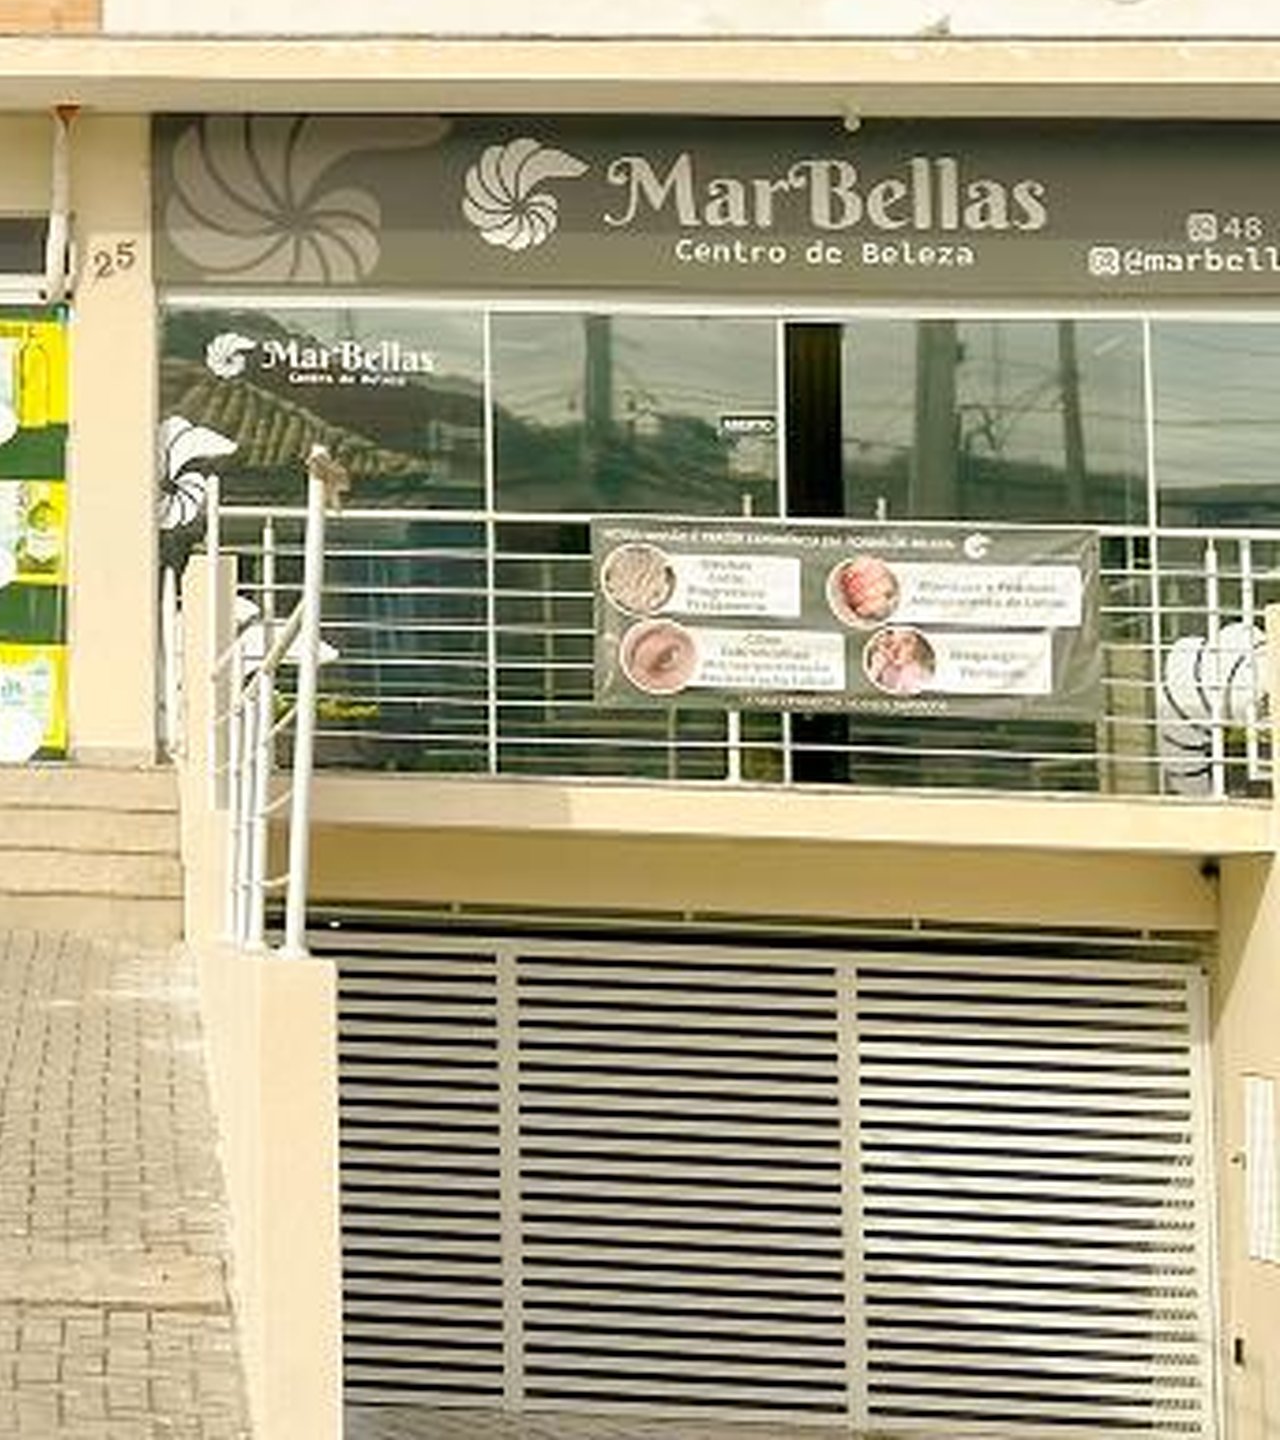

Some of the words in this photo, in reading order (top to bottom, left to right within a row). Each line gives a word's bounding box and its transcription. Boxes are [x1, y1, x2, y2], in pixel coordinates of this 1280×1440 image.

[603, 154, 1048, 231] MarBellas
[1223, 216, 1263, 241] 48
[93, 240, 137, 278] 25
[675, 239, 787, 265] Centro
[805, 240, 842, 264] de
[862, 242, 974, 266] Beleza
[260, 339, 436, 373] MarBellas
